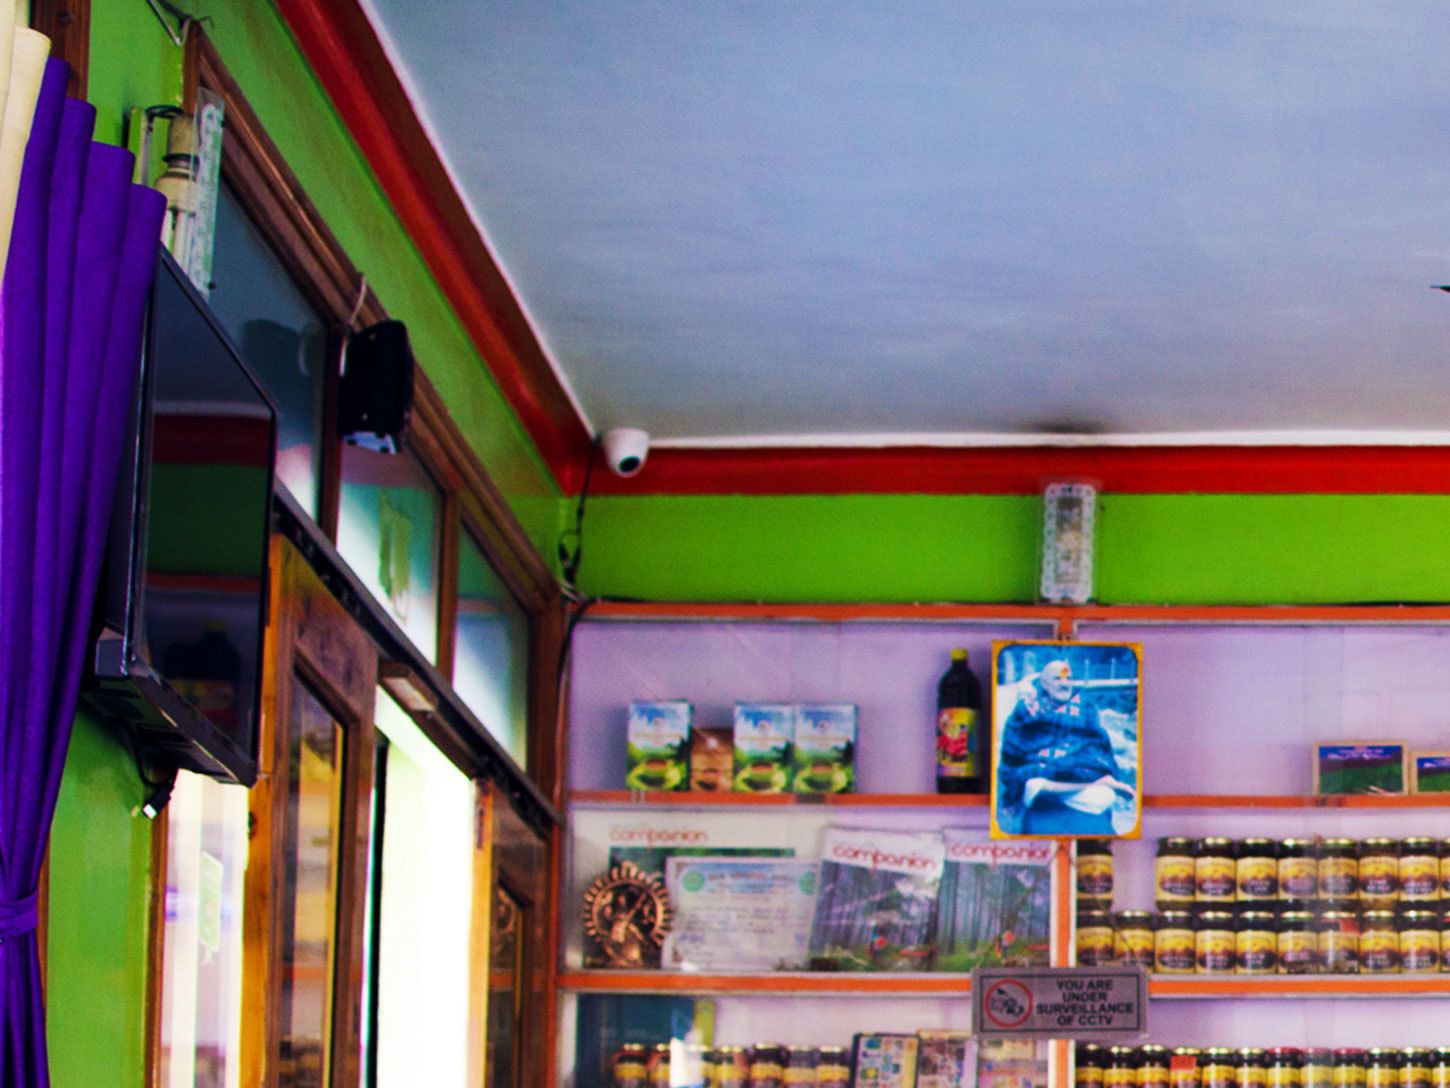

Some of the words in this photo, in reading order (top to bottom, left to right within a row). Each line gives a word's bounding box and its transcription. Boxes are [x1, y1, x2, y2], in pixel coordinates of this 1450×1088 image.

[832, 844, 936, 876] companion
[1056, 979, 1084, 990] YOU
[1087, 979, 1113, 990] ARE
[1062, 991, 1107, 1002] UNDER
[1036, 1003, 1134, 1014] SURVEILLANCE
[1057, 1015, 1073, 1026] OF
[1078, 1015, 1113, 1026] CCTV
